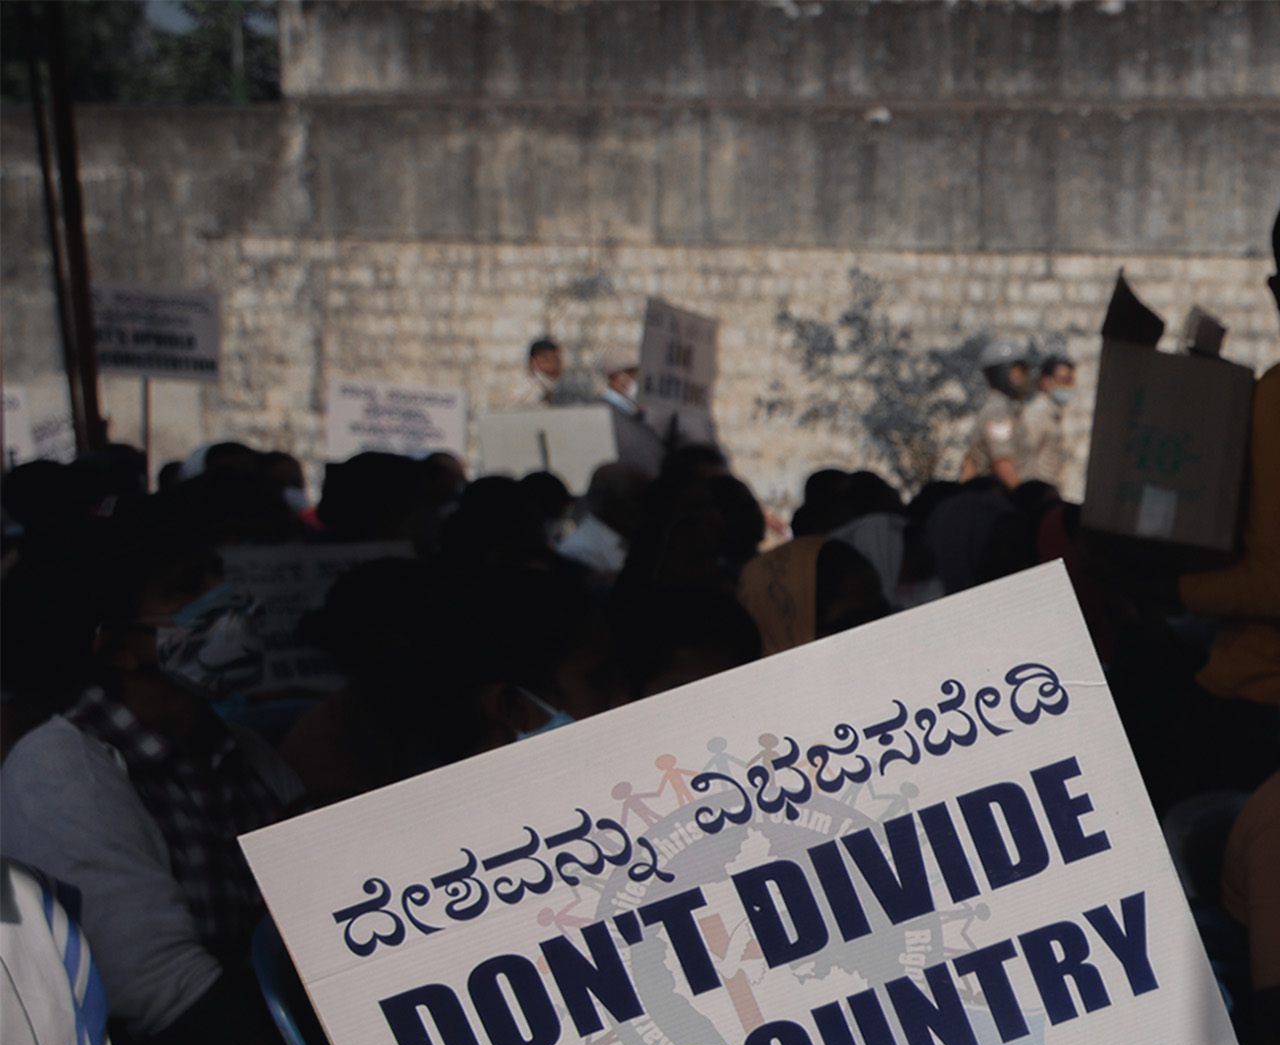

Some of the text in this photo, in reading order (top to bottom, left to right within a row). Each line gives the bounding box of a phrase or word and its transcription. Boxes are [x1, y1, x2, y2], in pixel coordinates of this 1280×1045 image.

[332, 663, 1069, 959] ದೇಶವನ್ನು ವಿಭಜಿಸಬೇಡಿ
[731, 757, 1111, 970] DIVIDE
